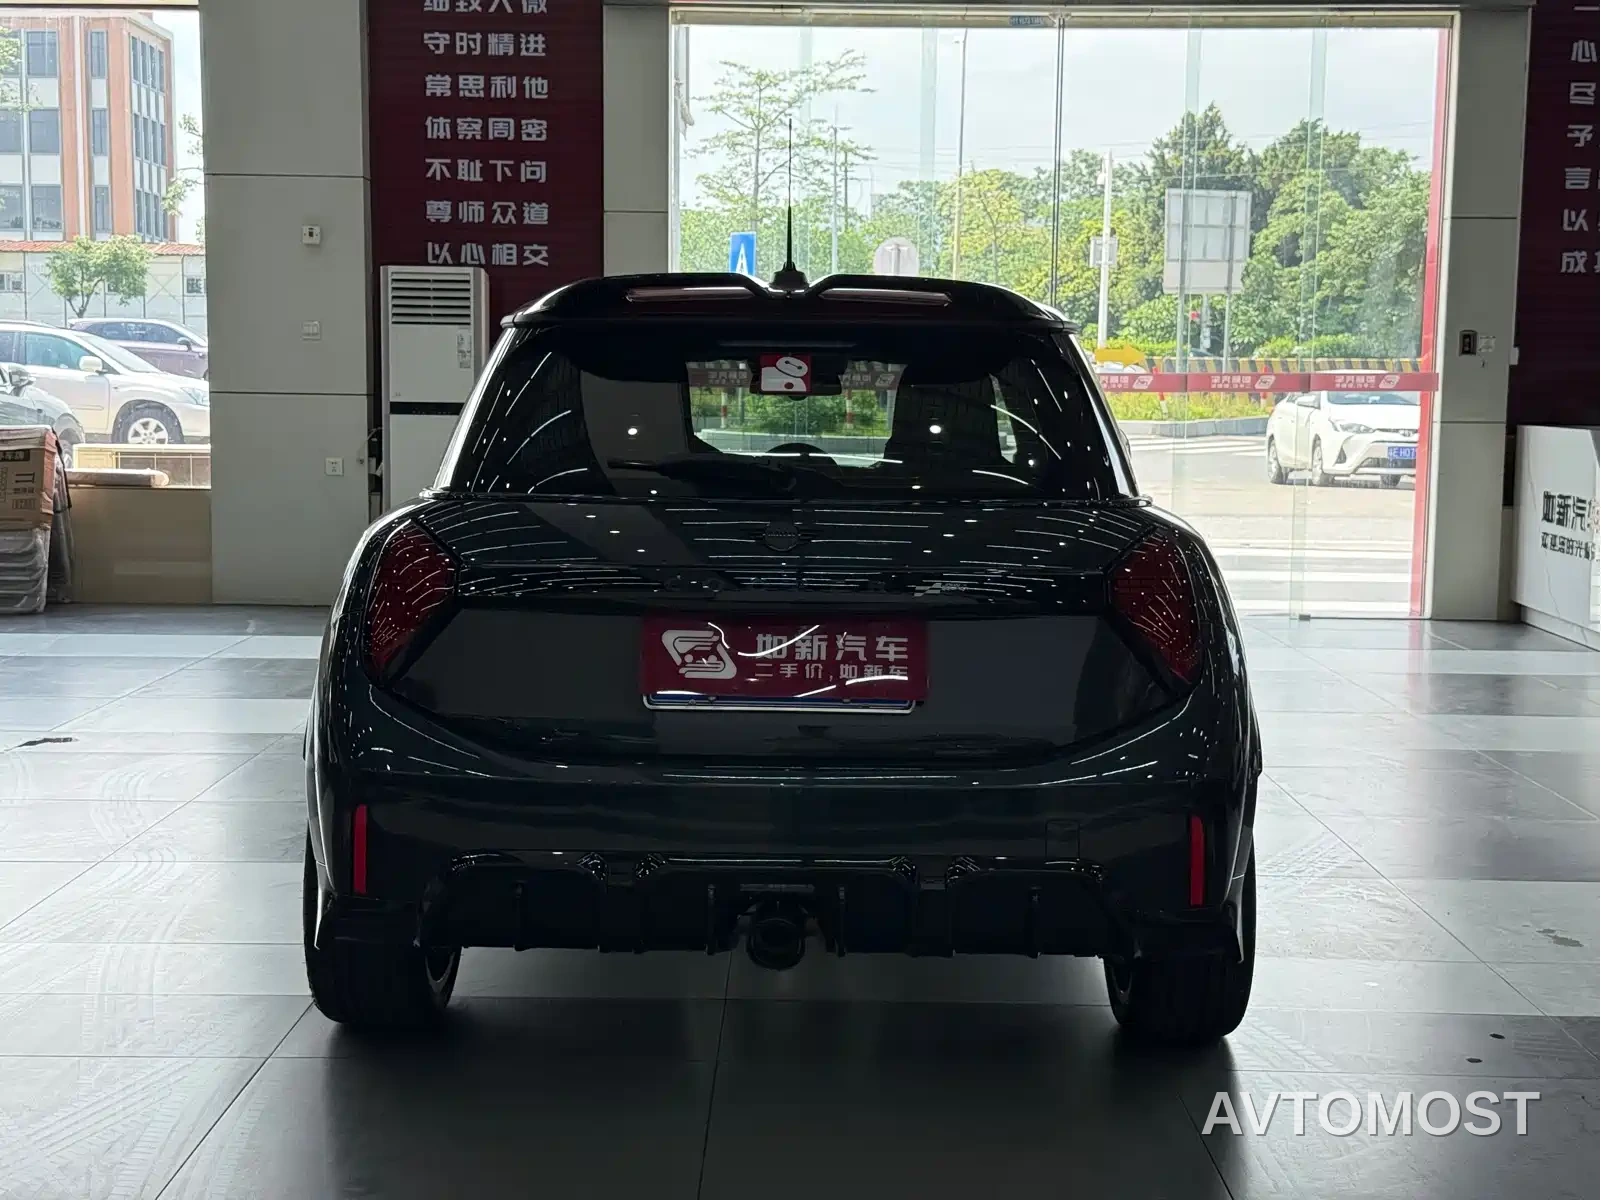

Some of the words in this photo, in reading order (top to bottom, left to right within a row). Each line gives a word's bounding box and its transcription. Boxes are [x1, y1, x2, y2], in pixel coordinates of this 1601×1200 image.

[424, 32, 546, 56] 守时精进
[1571, 40, 1597, 62] 心
[425, 74, 548, 99] 常思利他
[1570, 82, 1596, 104] 尽
[425, 117, 548, 141] 体察周密
[1567, 124, 1593, 147] 予
[425, 158, 547, 183] 不耻下问
[1565, 167, 1600, 189] 言
[426, 200, 549, 225] 尊师众道
[1563, 208, 1600, 231] 以
[427, 242, 549, 266] 以心相交
[1561, 251, 1600, 273] 成
[1541, 490, 1597, 532] 如新汽
[756, 633, 908, 661] 如新汽车
